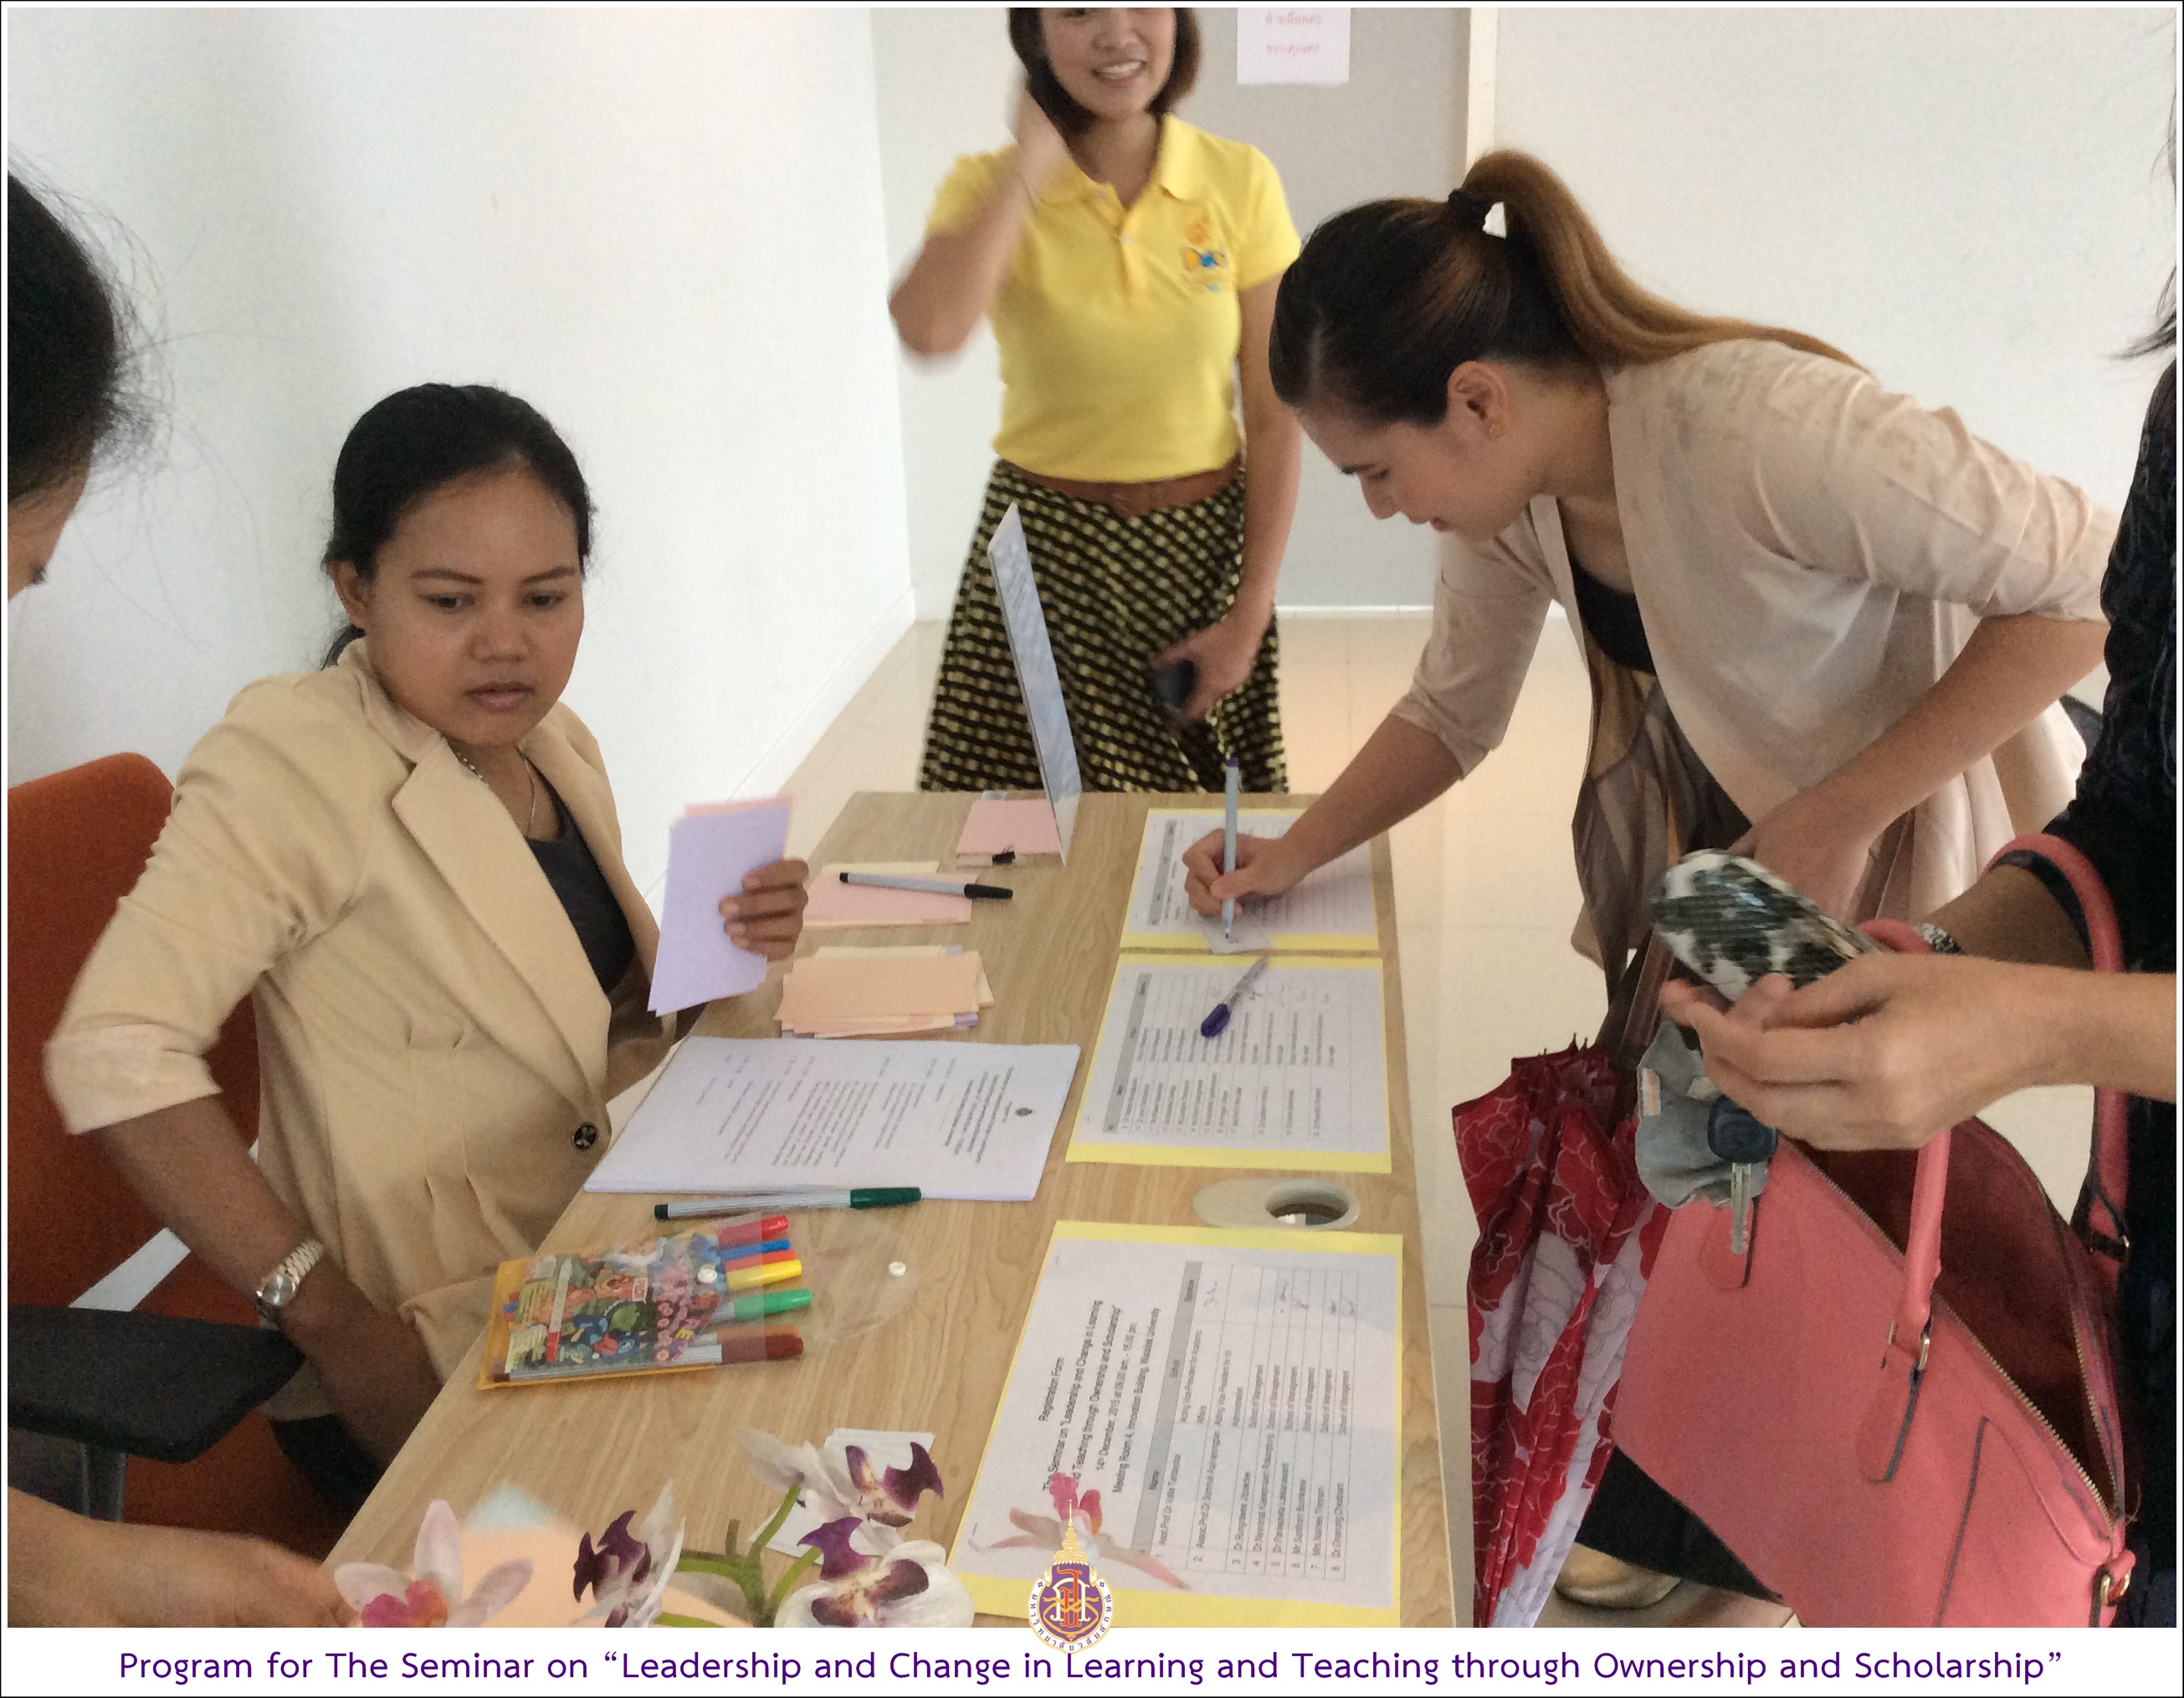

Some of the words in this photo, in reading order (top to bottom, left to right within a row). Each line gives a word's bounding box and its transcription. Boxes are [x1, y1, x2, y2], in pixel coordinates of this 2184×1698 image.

[1085, 1300, 1104, 1330] Learning
[1145, 1307, 1161, 1336] University
[1075, 1338, 1094, 1367] Change
[1099, 1348, 1110, 1362] and
[1038, 1377, 1061, 1421] Registration
[1050, 1357, 1064, 1376] Form
[1071, 1367, 1084, 1382] and
[1089, 1363, 1109, 1402] Ownership
[1082, 1403, 1100, 1433] through
[1126, 1394, 1141, 1430] Innovation
[1057, 1427, 1069, 1439] on
[1047, 1439, 1066, 1473] Seminar
[1072, 1434, 1093, 1470] Teaching
[1118, 1439, 1132, 1462] Room
[1111, 1461, 1130, 1494] Meeting
